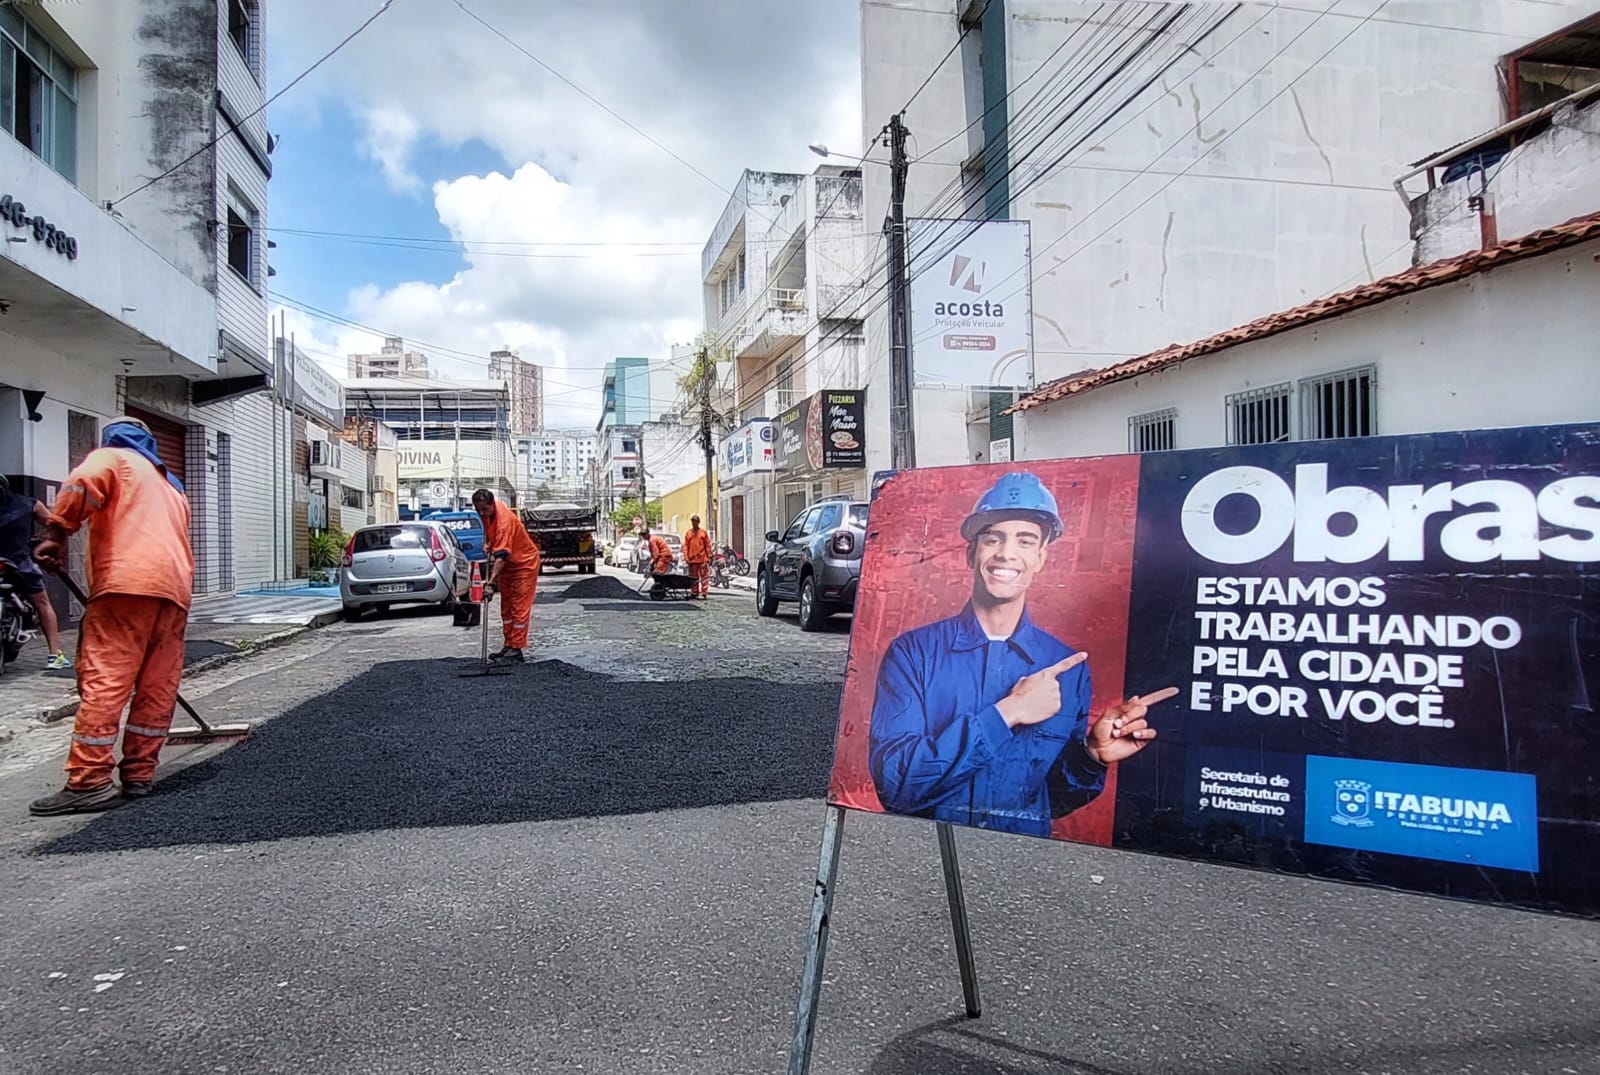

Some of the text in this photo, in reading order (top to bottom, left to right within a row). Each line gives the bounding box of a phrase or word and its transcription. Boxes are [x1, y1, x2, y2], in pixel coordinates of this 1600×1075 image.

[935, 300, 1004, 317] acosta
[935, 319, 1006, 328] Proteção Veicular
[830, 418, 857, 430] Massa
[1181, 463, 1600, 563] Obras
[1196, 577, 1386, 607] ESTAMOS
[1195, 611, 1522, 649] TRABALHANDO
[1193, 646, 1464, 688] PELA CIDADE
[1190, 682, 1455, 728] E POR VOCÊ.
[1200, 767, 1290, 787] Secretaria de
[1200, 781, 1290, 802] Infraestrutura
[1199, 796, 1285, 816] e Urbanismo
[1375, 791, 1512, 823] ITABUNA
[1386, 811, 1499, 830] PREFEITURA
